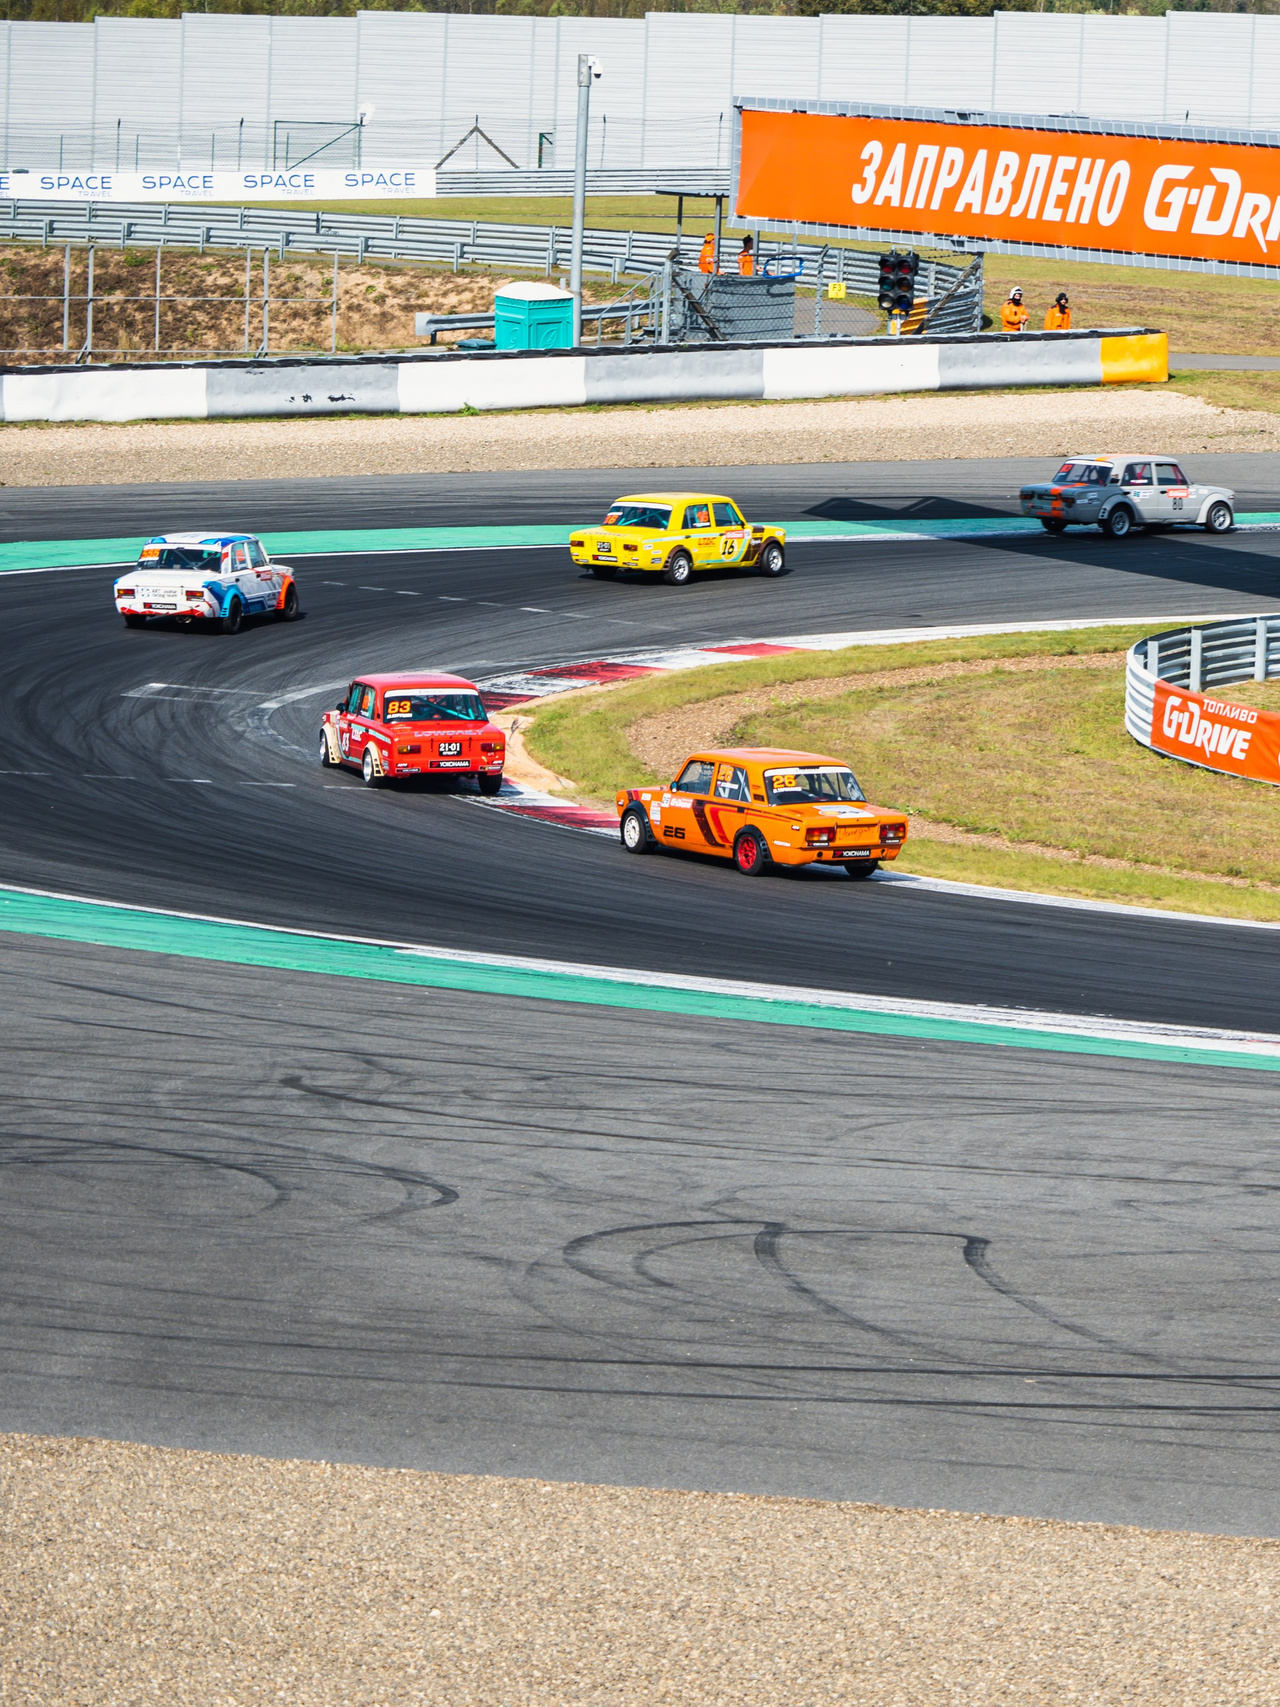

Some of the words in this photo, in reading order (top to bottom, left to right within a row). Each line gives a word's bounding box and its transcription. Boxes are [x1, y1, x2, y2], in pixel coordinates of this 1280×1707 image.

[40, 176, 112, 190] SPACE
[142, 175, 214, 189] SPACE
[243, 174, 315, 188] SPACE
[345, 173, 415, 187] SPACE
[852, 140, 1130, 227] ЗАПРАВЛЕНО
[78, 190, 112, 198] TRAVEL
[281, 188, 315, 196] TRAVEL
[1172, 498, 1183, 510] 80
[603, 515, 619, 524] 16
[141, 549, 161, 558] 555
[721, 540, 735, 555] 16
[388, 701, 411, 714] 83
[1203, 699, 1258, 724] ТОПЛИВО
[439, 743, 460, 751] 21-01
[717, 765, 734, 782] 26
[772, 775, 796, 788] 26
[663, 825, 685, 839] 26
